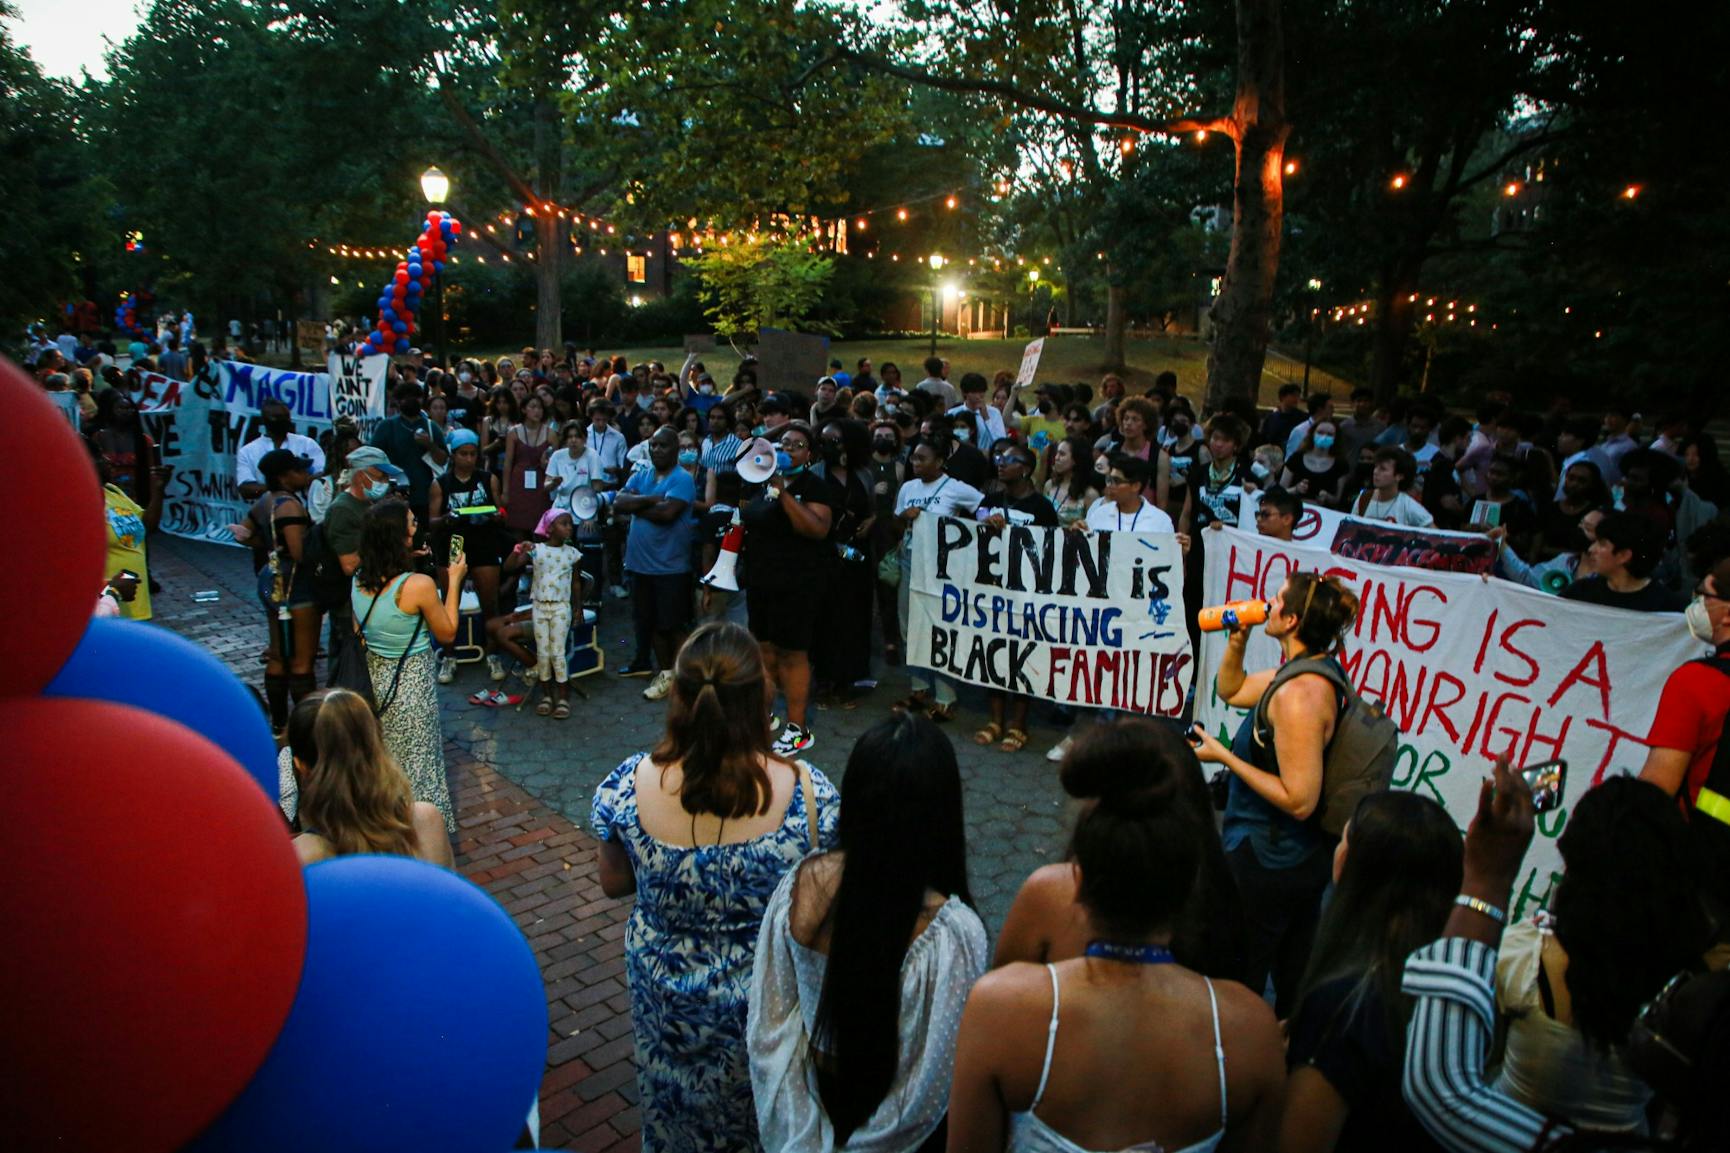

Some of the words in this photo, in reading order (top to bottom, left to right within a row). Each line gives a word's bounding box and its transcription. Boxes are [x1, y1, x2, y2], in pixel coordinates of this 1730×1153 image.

[341, 353, 363, 377] WE
[936, 515, 1113, 599] PENN
[942, 583, 1123, 647] DISPLACING
[930, 626, 1038, 695] BLACK
[1046, 646, 1192, 718] FAMILIES
[1473, 608, 1546, 686] IS
[1547, 640, 1612, 722] A
